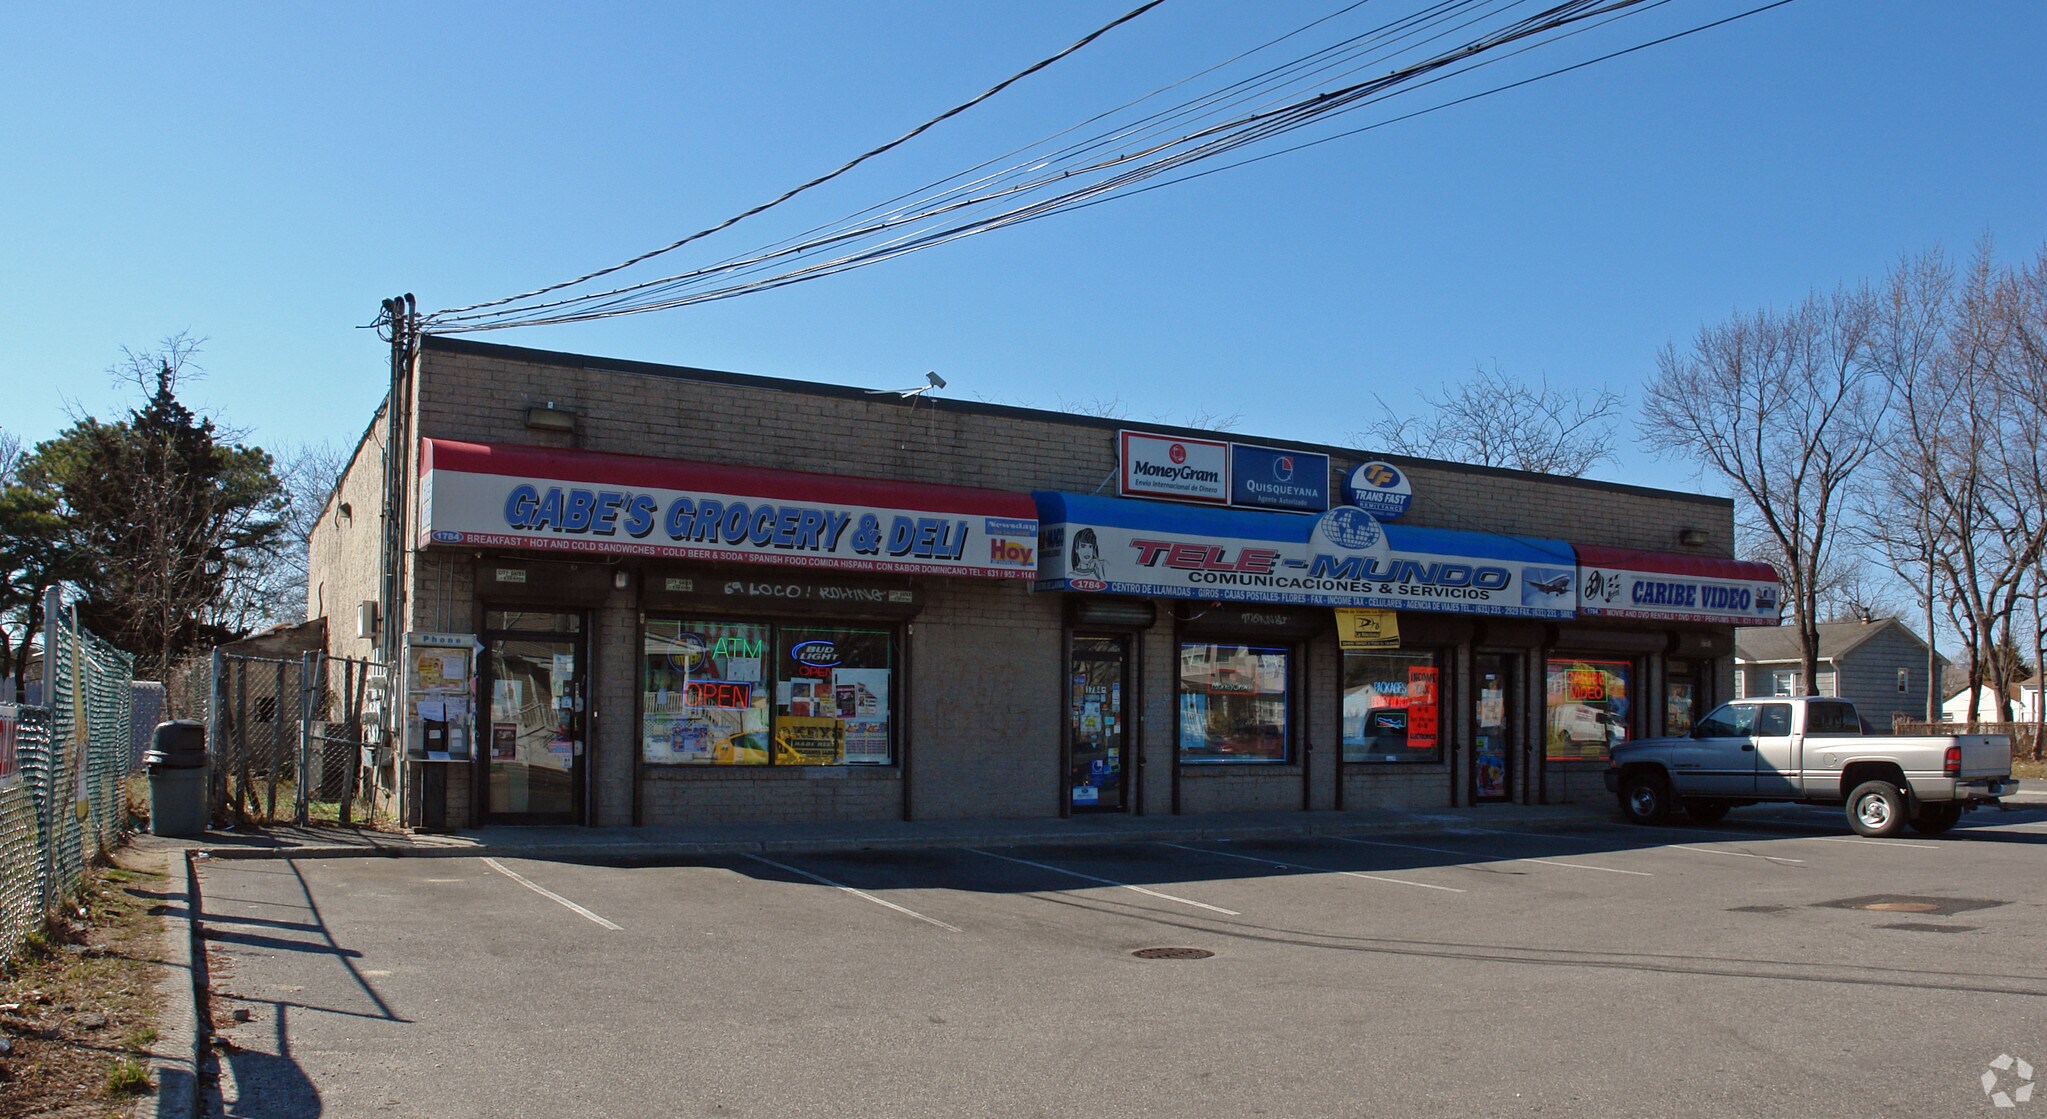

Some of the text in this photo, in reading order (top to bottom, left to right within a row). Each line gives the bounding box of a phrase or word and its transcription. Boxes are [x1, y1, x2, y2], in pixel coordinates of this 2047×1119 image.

[1134, 461, 1218, 483] MoneyGram
[1152, 481, 1191, 491] Internacional
[1199, 485, 1218, 494] Dinero
[1246, 479, 1319, 498] QUISQUEYANA
[1355, 489, 1407, 505] TRANS FAST
[1359, 502, 1403, 513] REMITTANCE
[504, 484, 968, 561] GABE'S GROCERY & DELI
[988, 520, 1037, 533] Newsday
[436, 531, 460, 540] 1784
[466, 533, 522, 545] BREAKFAST
[529, 538, 548, 547] HOT
[550, 539, 569, 549] AND
[571, 541, 596, 550] COLD
[597, 542, 655, 555] SANDWICHES
[662, 547, 686, 557] COLD
[687, 549, 710, 558] BEER
[712, 551, 718, 559] &
[720, 551, 743, 561] SODA
[749, 553, 781, 563] SPANISH
[784, 556, 806, 565] FOOD
[808, 557, 839, 567] COMIDA
[840, 560, 873, 569] HISPANA
[876, 562, 892, 570] CON
[894, 563, 920, 572] SABOR
[921, 565, 966, 575] DOMINICANO
[987, 568, 998, 576] 631
[991, 538, 1033, 566] Hoy
[1078, 580, 1100, 589] 1784
[1188, 572, 1490, 601] COMUNICACIONES & SERVICIOS
[1111, 581, 1140, 593] CENTRO
[1142, 583, 1150, 593] DE
[1152, 584, 1190, 596] LLAMADAS
[1197, 587, 1218, 598] GIROS
[1224, 589, 1244, 599] CAJAS
[1281, 592, 1306, 602] FLORES
[1310, 594, 1322, 603] FAX
[1327, 595, 1350, 605] INCOME
[1352, 597, 1364, 605] TAX
[1368, 597, 1402, 608] CELULARES
[1406, 600, 1430, 610] AGENCIA
[1432, 601, 1440, 610] DE
[1440, 602, 1459, 611] VIAJES
[1632, 580, 1751, 610] CARIBE VIDEO
[1606, 608, 1624, 617] MOVIE
[1624, 609, 1636, 617] AND
[1637, 610, 1649, 618] DVD
[1649, 611, 1674, 620] RENTALS
[423, 635, 462, 645] Phone
[712, 637, 763, 660] ATM
[805, 645, 835, 654] BUD
[800, 652, 838, 661] LIGHT
[1373, 681, 1408, 694] PACKAGES
[1570, 686, 1604, 700] VIDEO
[683, 683, 750, 708] OPEN
